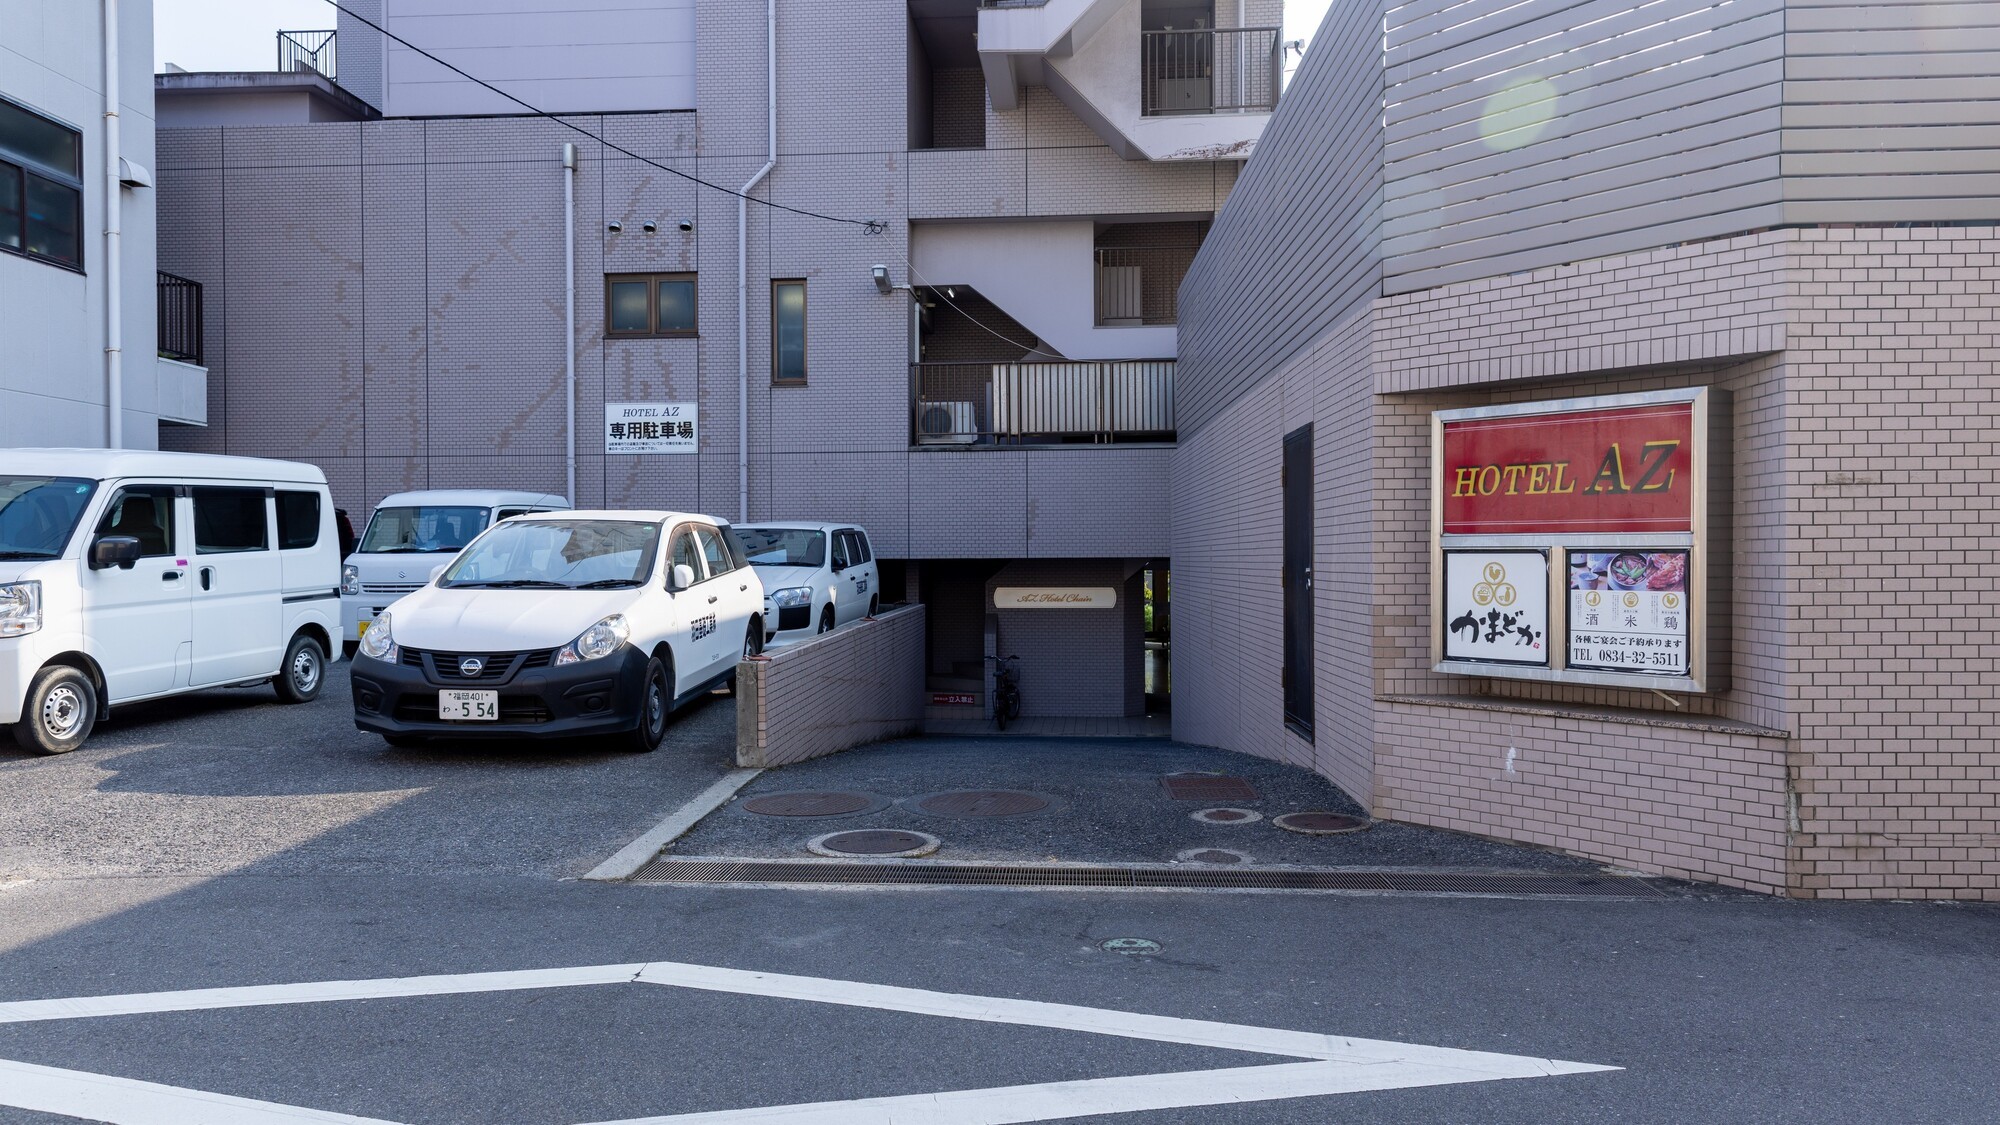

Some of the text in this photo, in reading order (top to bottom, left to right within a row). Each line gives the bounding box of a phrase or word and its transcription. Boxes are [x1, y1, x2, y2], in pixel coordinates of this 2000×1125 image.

[623, 406, 680, 418] HOTEL AZ
[609, 421, 694, 440] 専用駐車場
[1451, 439, 1681, 498] HOTEL AZ
[1016, 593, 1092, 603] AZ Hotel Chain
[1449, 607, 1542, 647] かまどか
[1585, 613, 1679, 631] 酒 米 鶏
[1574, 634, 1682, 648] 各種ご宴会ご予約承ります
[1573, 647, 1680, 667] TEL 0834-32-5511
